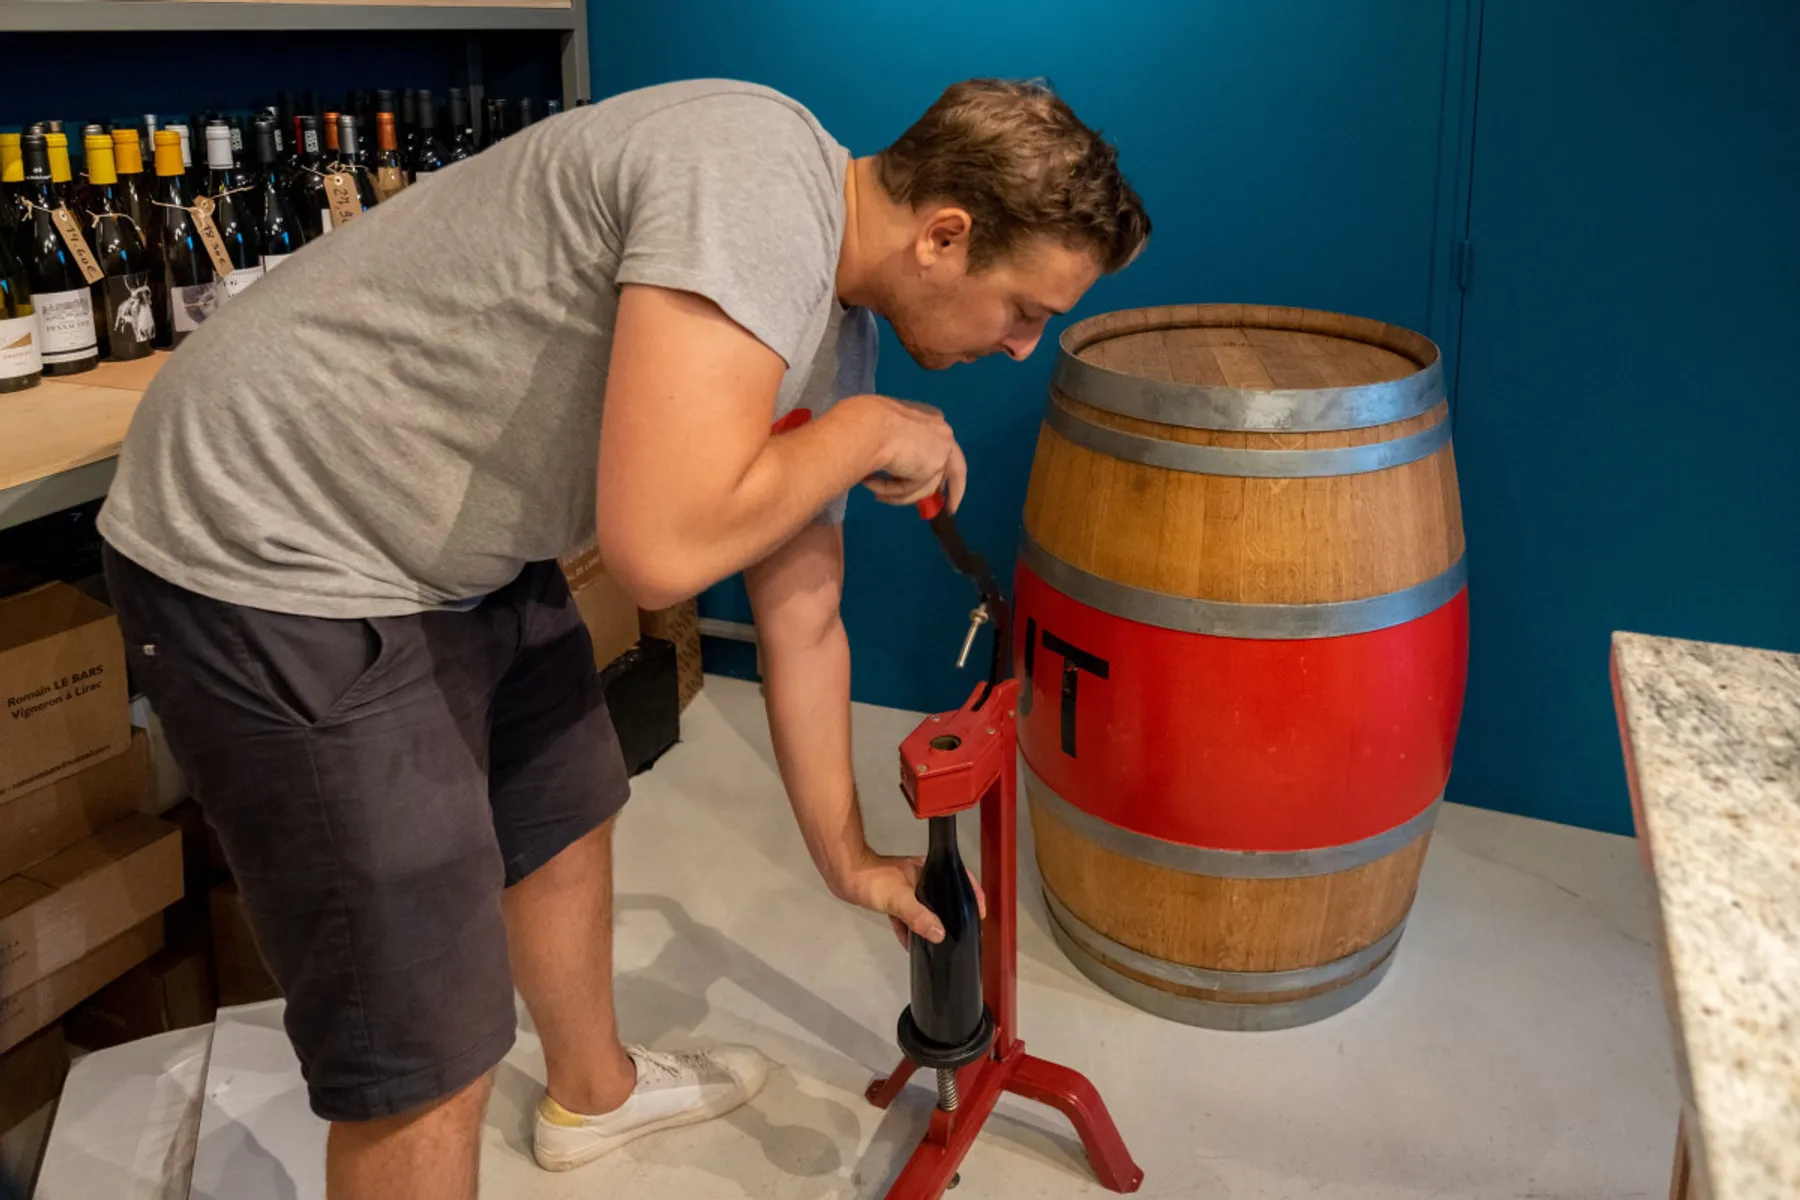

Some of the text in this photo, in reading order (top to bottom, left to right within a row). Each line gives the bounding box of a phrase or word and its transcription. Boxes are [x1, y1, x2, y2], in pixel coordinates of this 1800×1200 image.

[7, 664, 104, 708] Romain LE BARS
[10, 695, 63, 720] Vigneron
[74, 681, 103, 697] Lirac
